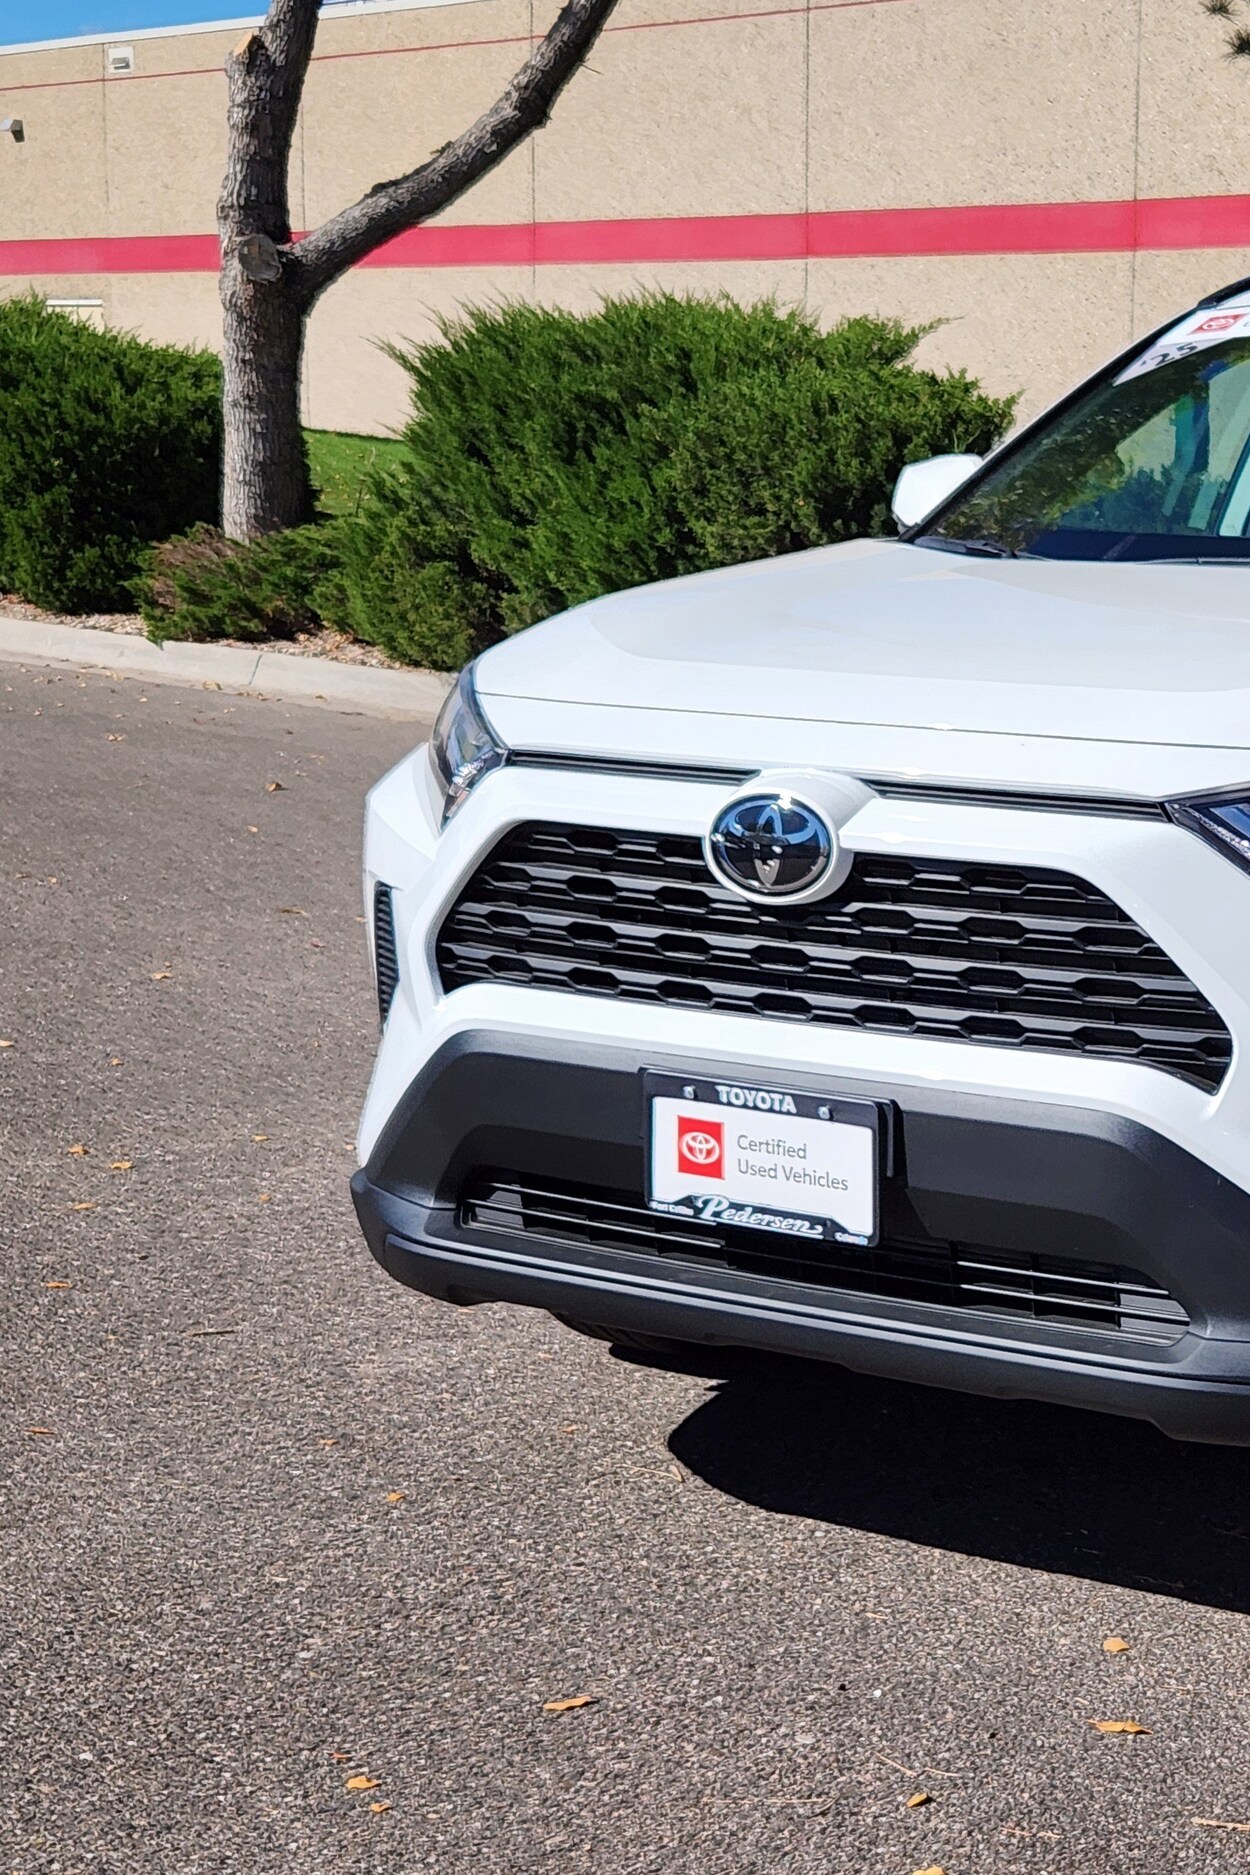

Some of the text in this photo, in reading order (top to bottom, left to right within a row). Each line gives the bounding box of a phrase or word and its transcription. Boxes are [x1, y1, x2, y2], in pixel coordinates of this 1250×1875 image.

[714, 1085, 797, 1114] TOYOTA
[737, 1134, 807, 1160] Certified
[737, 1158, 849, 1191] Used Vehicles
[698, 1195, 824, 1234] Pedersen
